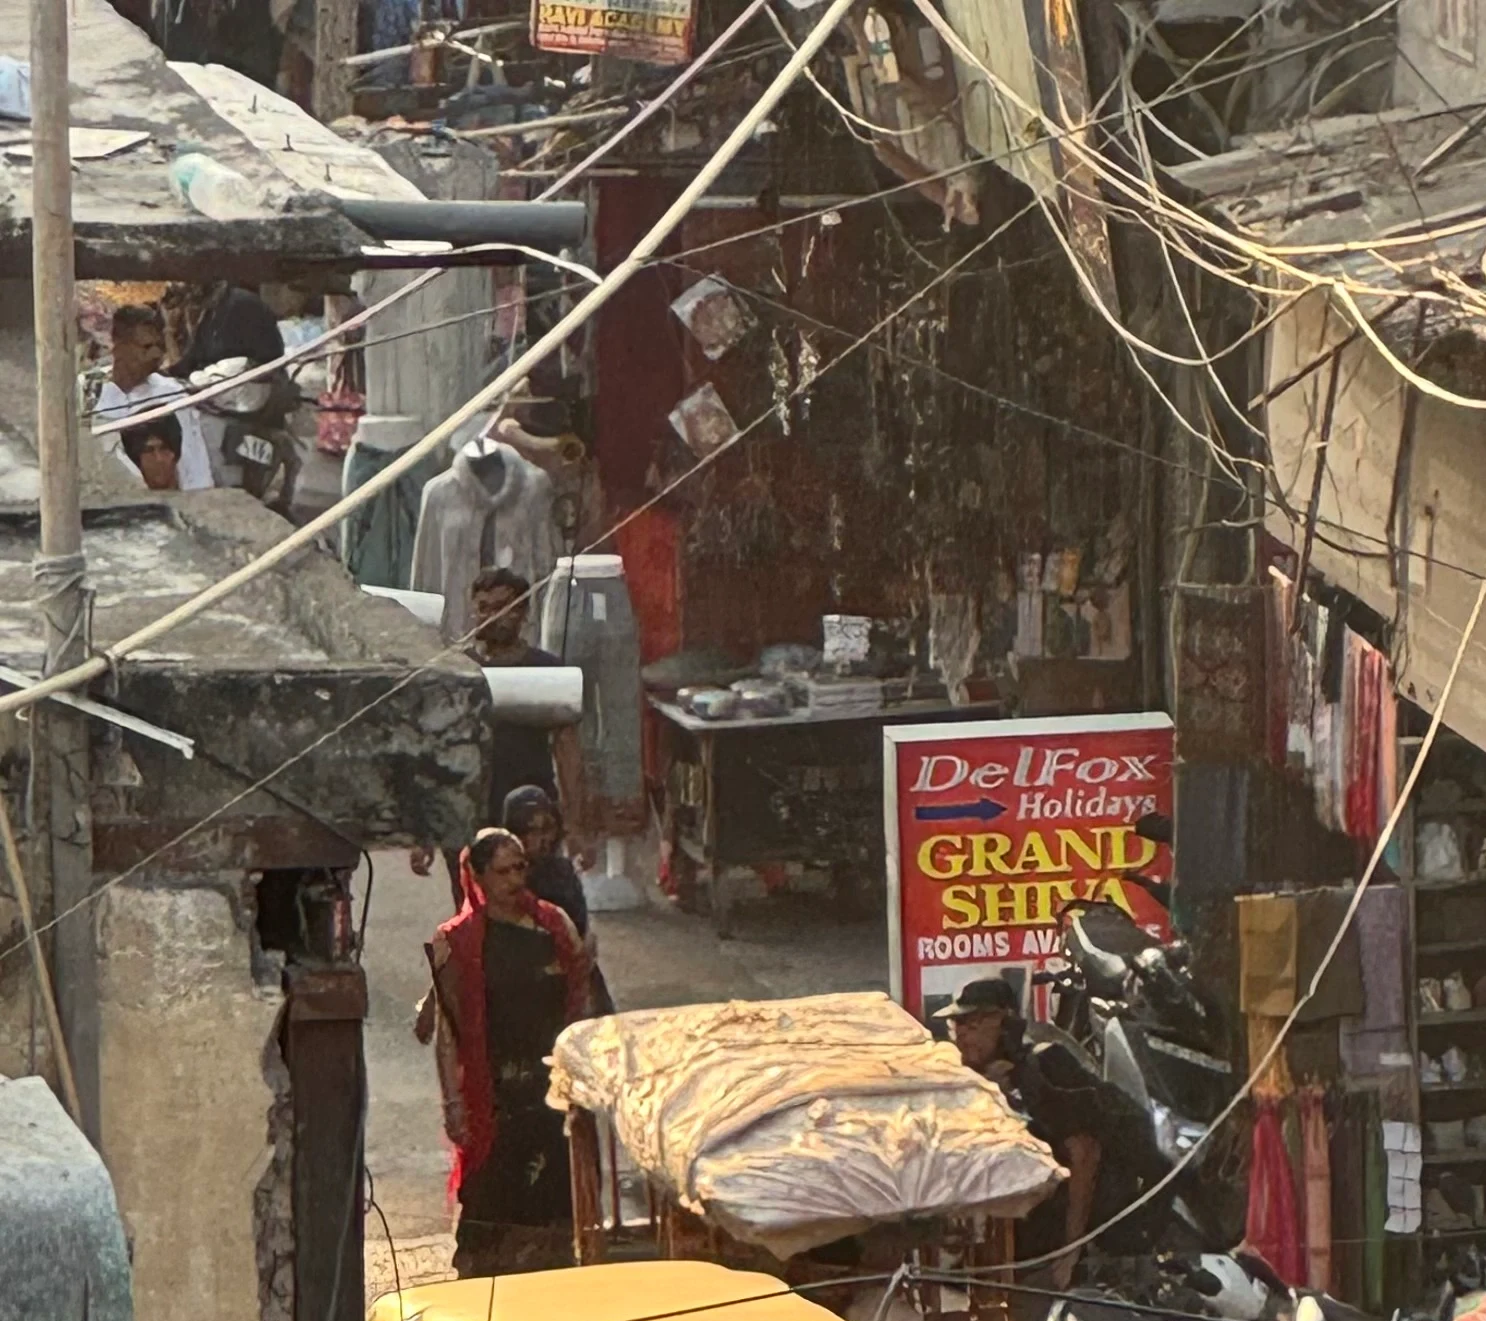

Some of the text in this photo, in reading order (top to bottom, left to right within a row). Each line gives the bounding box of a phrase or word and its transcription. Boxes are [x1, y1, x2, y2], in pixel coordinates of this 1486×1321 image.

[910, 746, 1157, 793] DelFox
[1016, 787, 1157, 823] Holidays
[917, 825, 1157, 880] GRAND
[917, 931, 1010, 961] ROOMS
